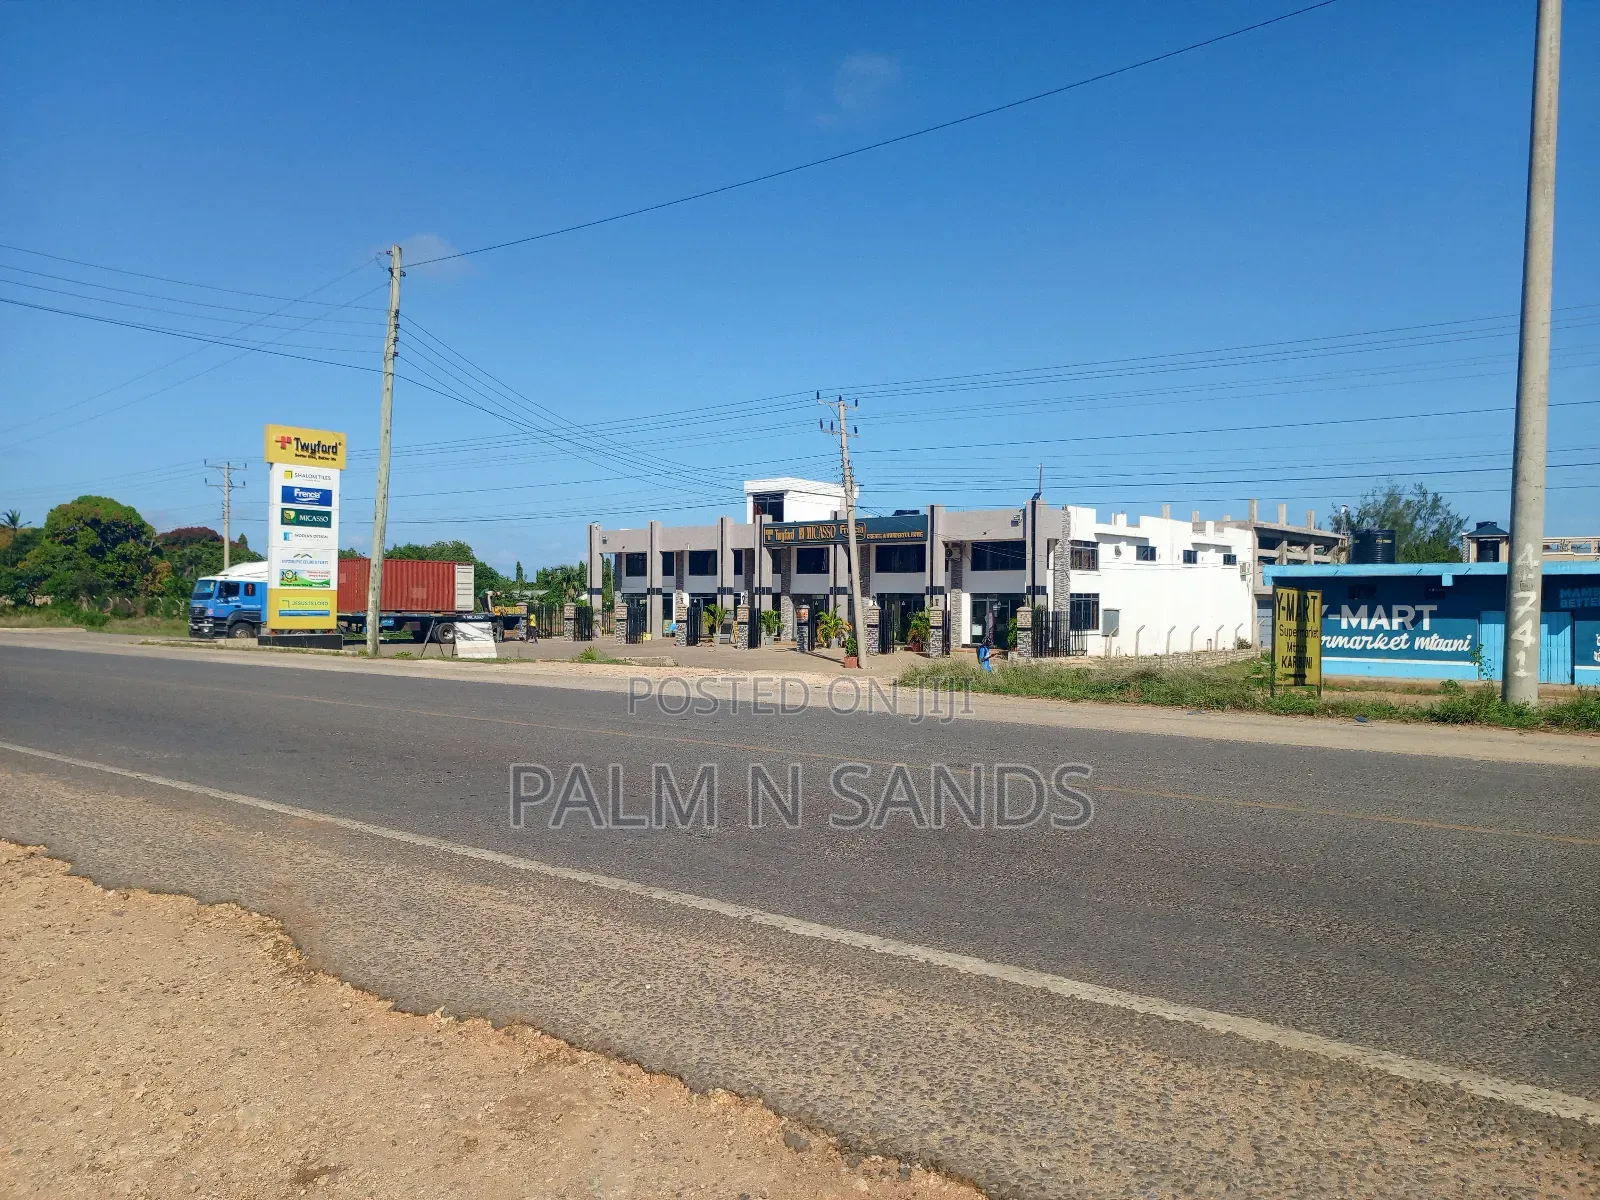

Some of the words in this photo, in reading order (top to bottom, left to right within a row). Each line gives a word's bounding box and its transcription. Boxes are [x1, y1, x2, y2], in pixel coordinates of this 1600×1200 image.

[294, 437, 338, 456] Twyford
[294, 488, 320, 498] Frencia
[299, 514, 328, 522] MICASSO
[775, 528, 794, 542] Twyford
[807, 525, 836, 539] MICASSO
[1276, 592, 1318, 622] Y-MART
[1560, 598, 1600, 608] BETTE
[1321, 632, 1411, 650] rmarket
